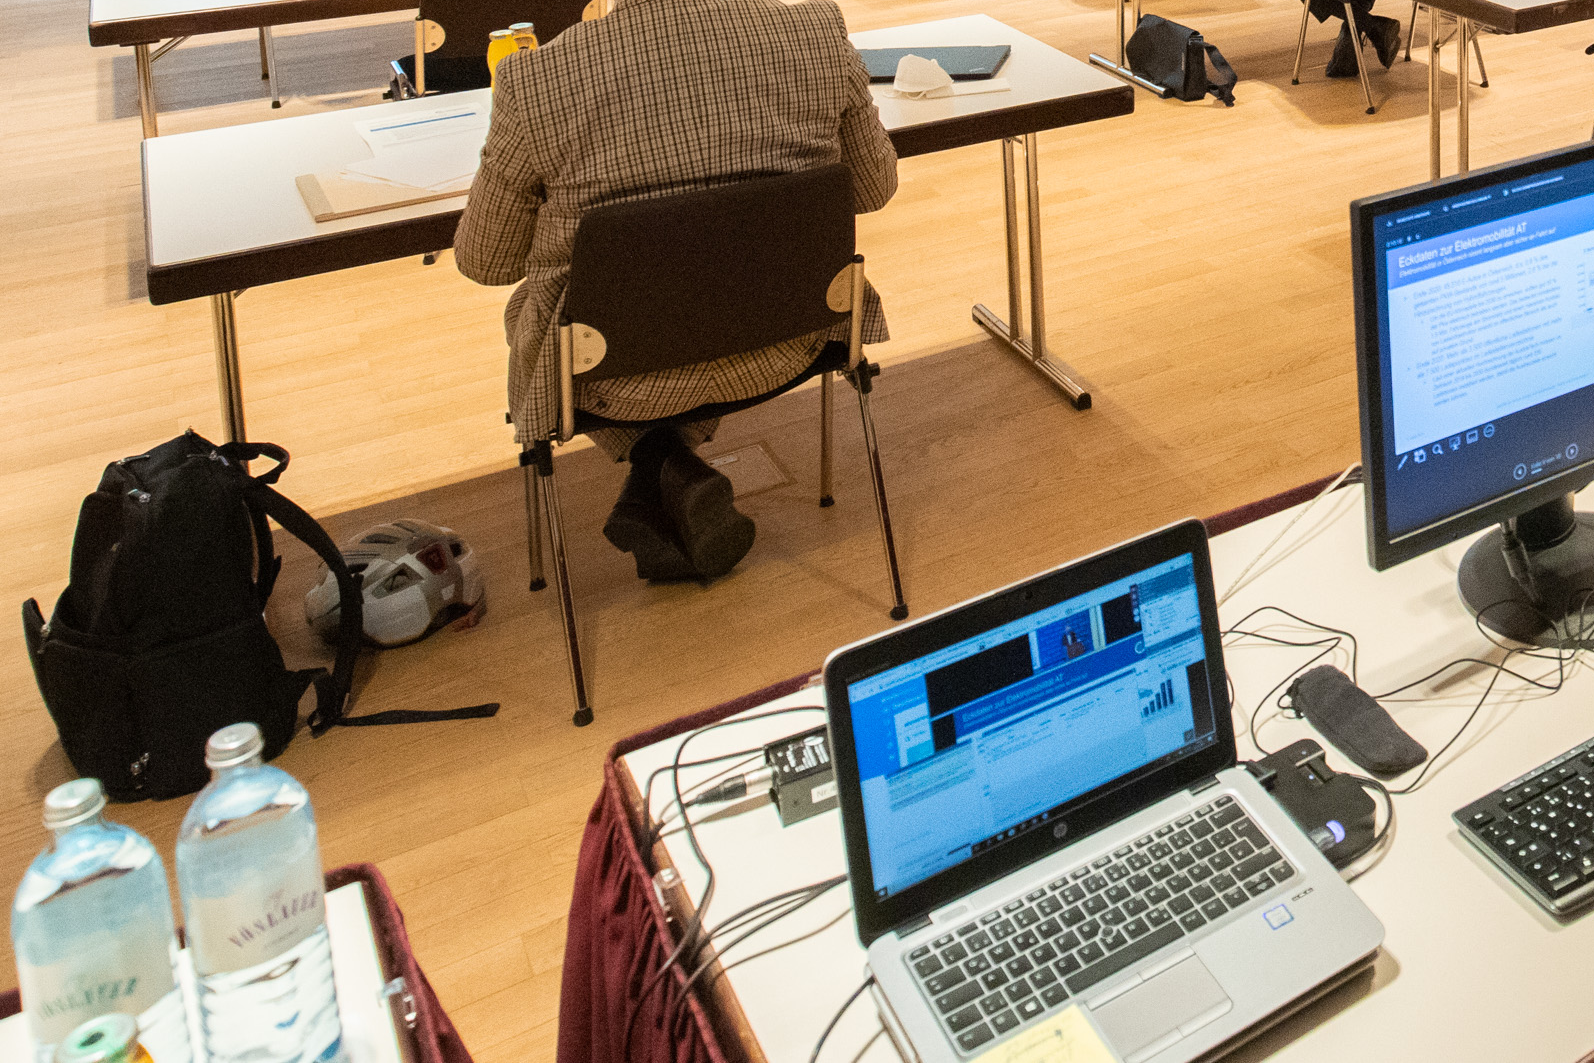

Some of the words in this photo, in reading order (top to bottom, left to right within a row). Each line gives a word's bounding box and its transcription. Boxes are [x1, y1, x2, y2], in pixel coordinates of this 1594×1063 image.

[1398, 246, 1437, 268] Eckdaten
[1439, 244, 1453, 256] zur
[1454, 224, 1514, 252] Elektromobilität
[1515, 221, 1526, 235] AT
